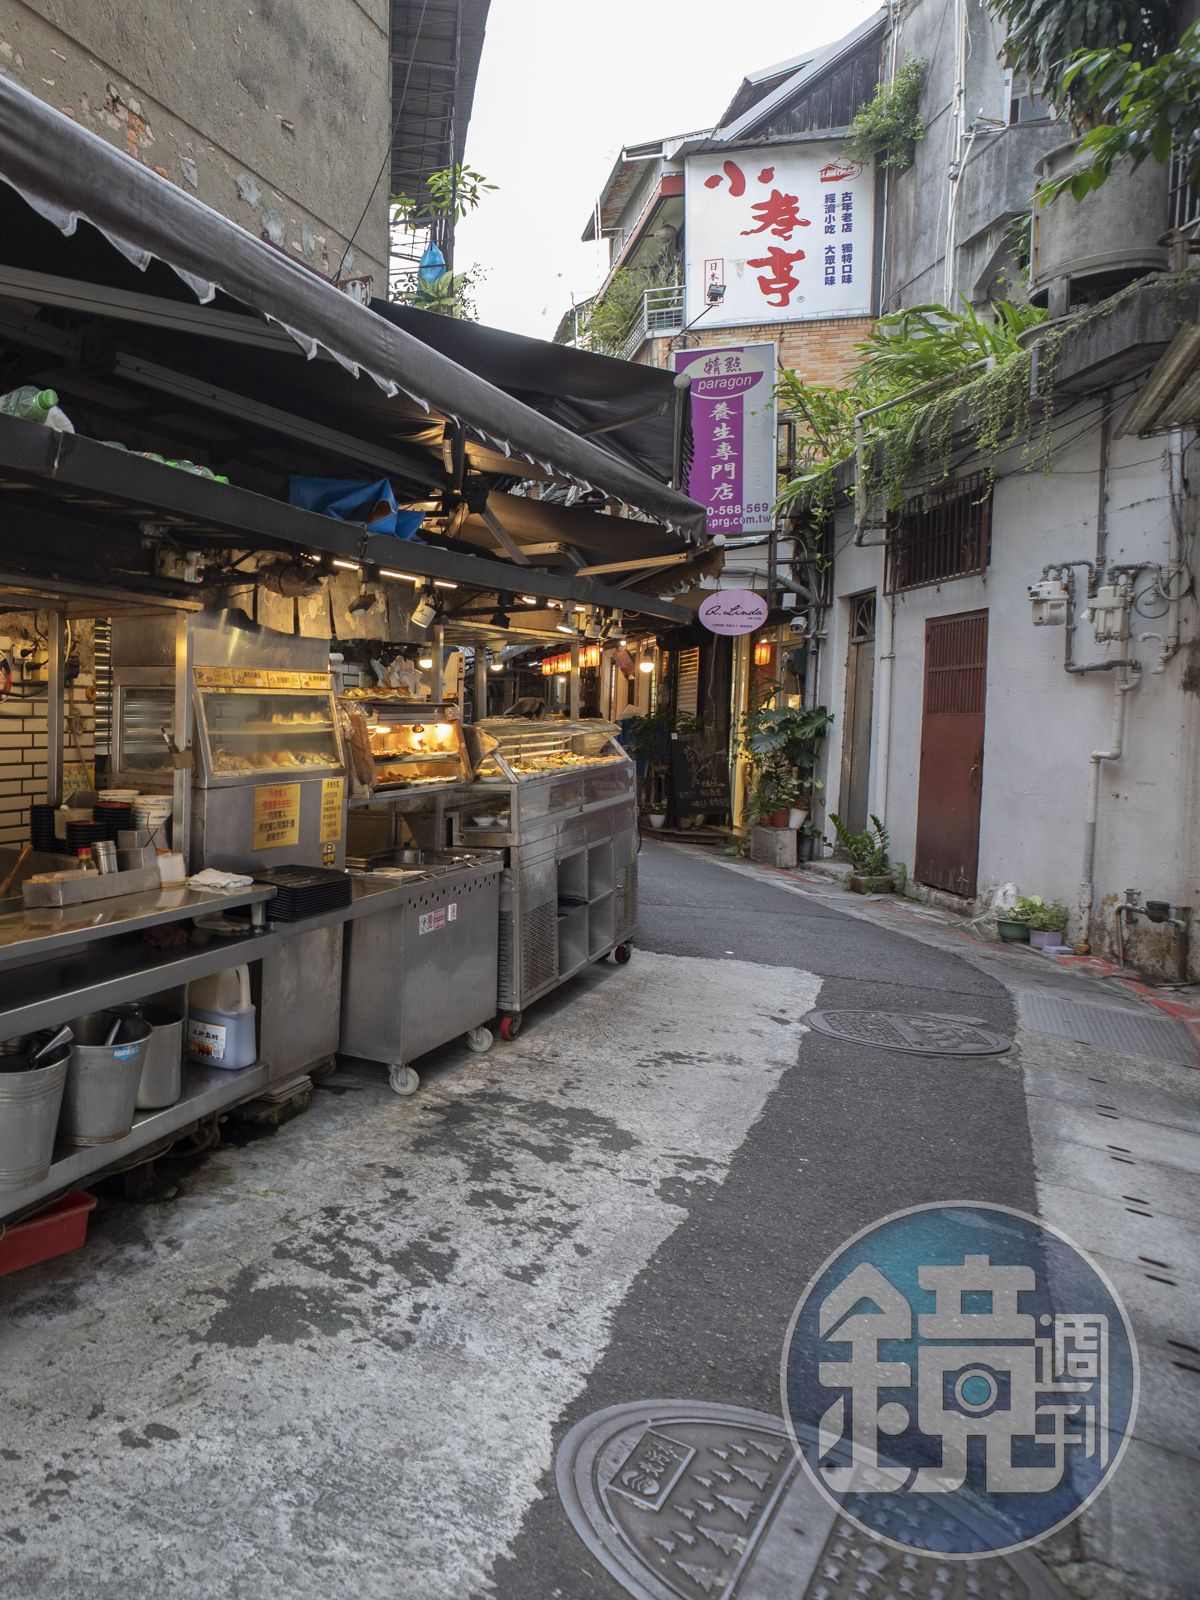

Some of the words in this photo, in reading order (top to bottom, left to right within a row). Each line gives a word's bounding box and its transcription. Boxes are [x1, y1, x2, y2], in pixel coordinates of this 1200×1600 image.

[697, 375, 752, 392] paragon
[709, 401, 738, 501] 養生專門店
[706, 514, 771, 528] .prg.com.tw
